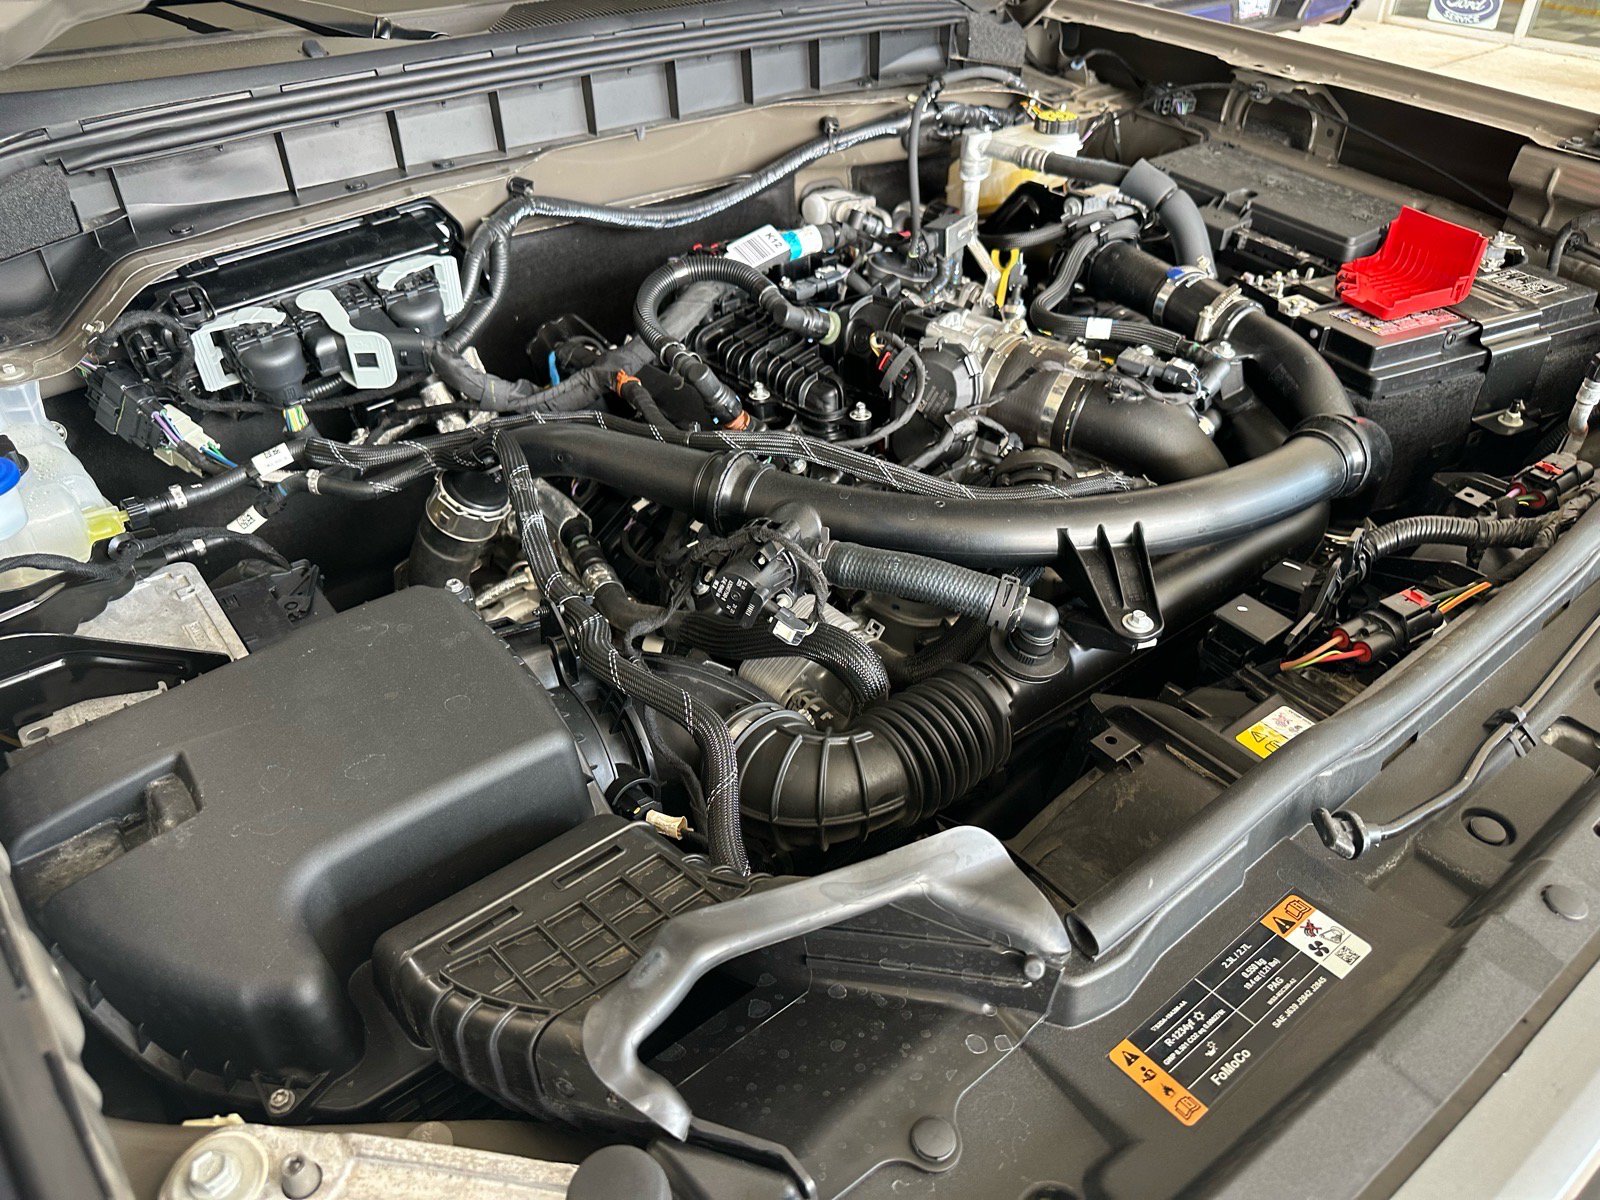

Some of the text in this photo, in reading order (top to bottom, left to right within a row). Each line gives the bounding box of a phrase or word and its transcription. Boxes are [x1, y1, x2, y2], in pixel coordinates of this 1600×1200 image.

[1443, 10, 1481, 24] SERVICE
[765, 232, 783, 249] K12
[1221, 956, 1238, 969] 2.3L
[1236, 943, 1252, 956] 2.7L
[1241, 957, 1268, 978] 0.550 kg
[1257, 965, 1272, 978] (1.21
[1266, 976, 1284, 992] PAG
[1271, 976, 1327, 1029] SAE J639 J2842 J2845
[1163, 1018, 1196, 1047] R-1234yf
[1186, 1032, 1200, 1044] CO2
[1210, 1049, 1251, 1086] FoMoCo
